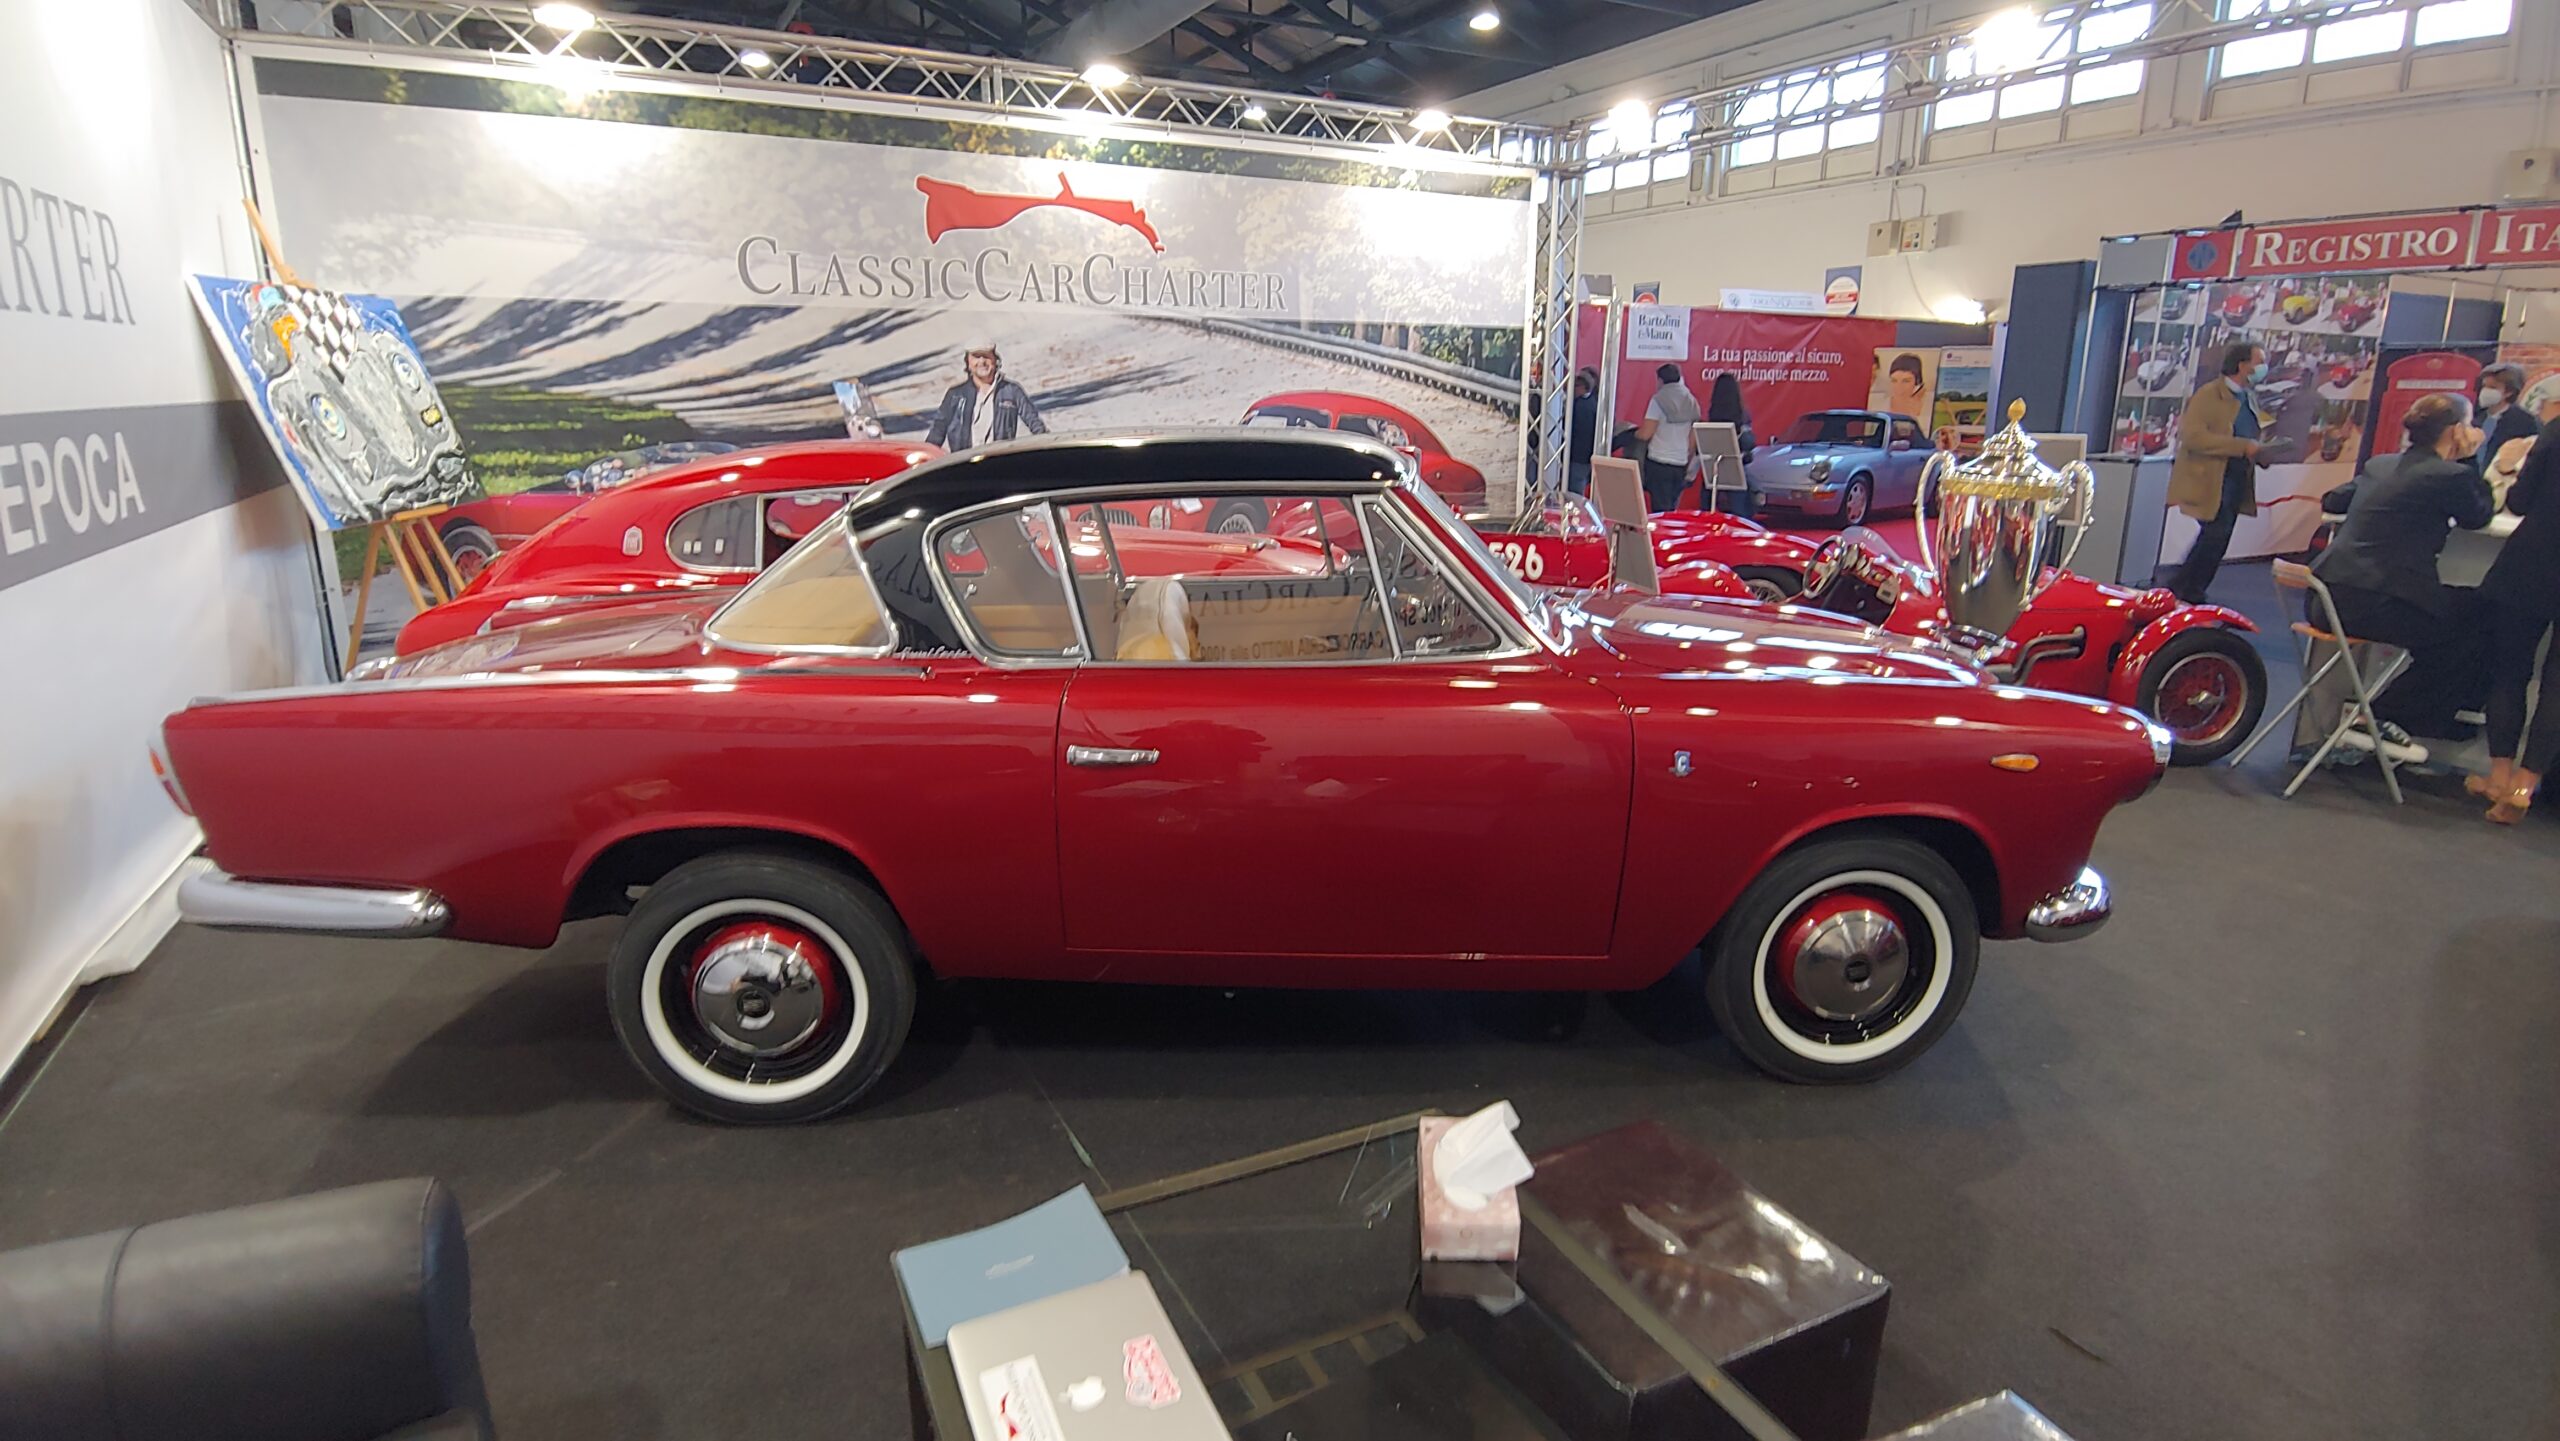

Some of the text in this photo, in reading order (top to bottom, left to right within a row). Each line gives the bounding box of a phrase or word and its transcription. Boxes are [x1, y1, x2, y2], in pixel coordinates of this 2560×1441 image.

[0, 176, 137, 326] RTER
[2250, 226, 2459, 268] REGISTRO
[1638, 314, 1681, 328] Bartolini
[1703, 345, 1845, 366] La tua passione al sicuro,
[1789, 368, 1830, 382] mezzo.
